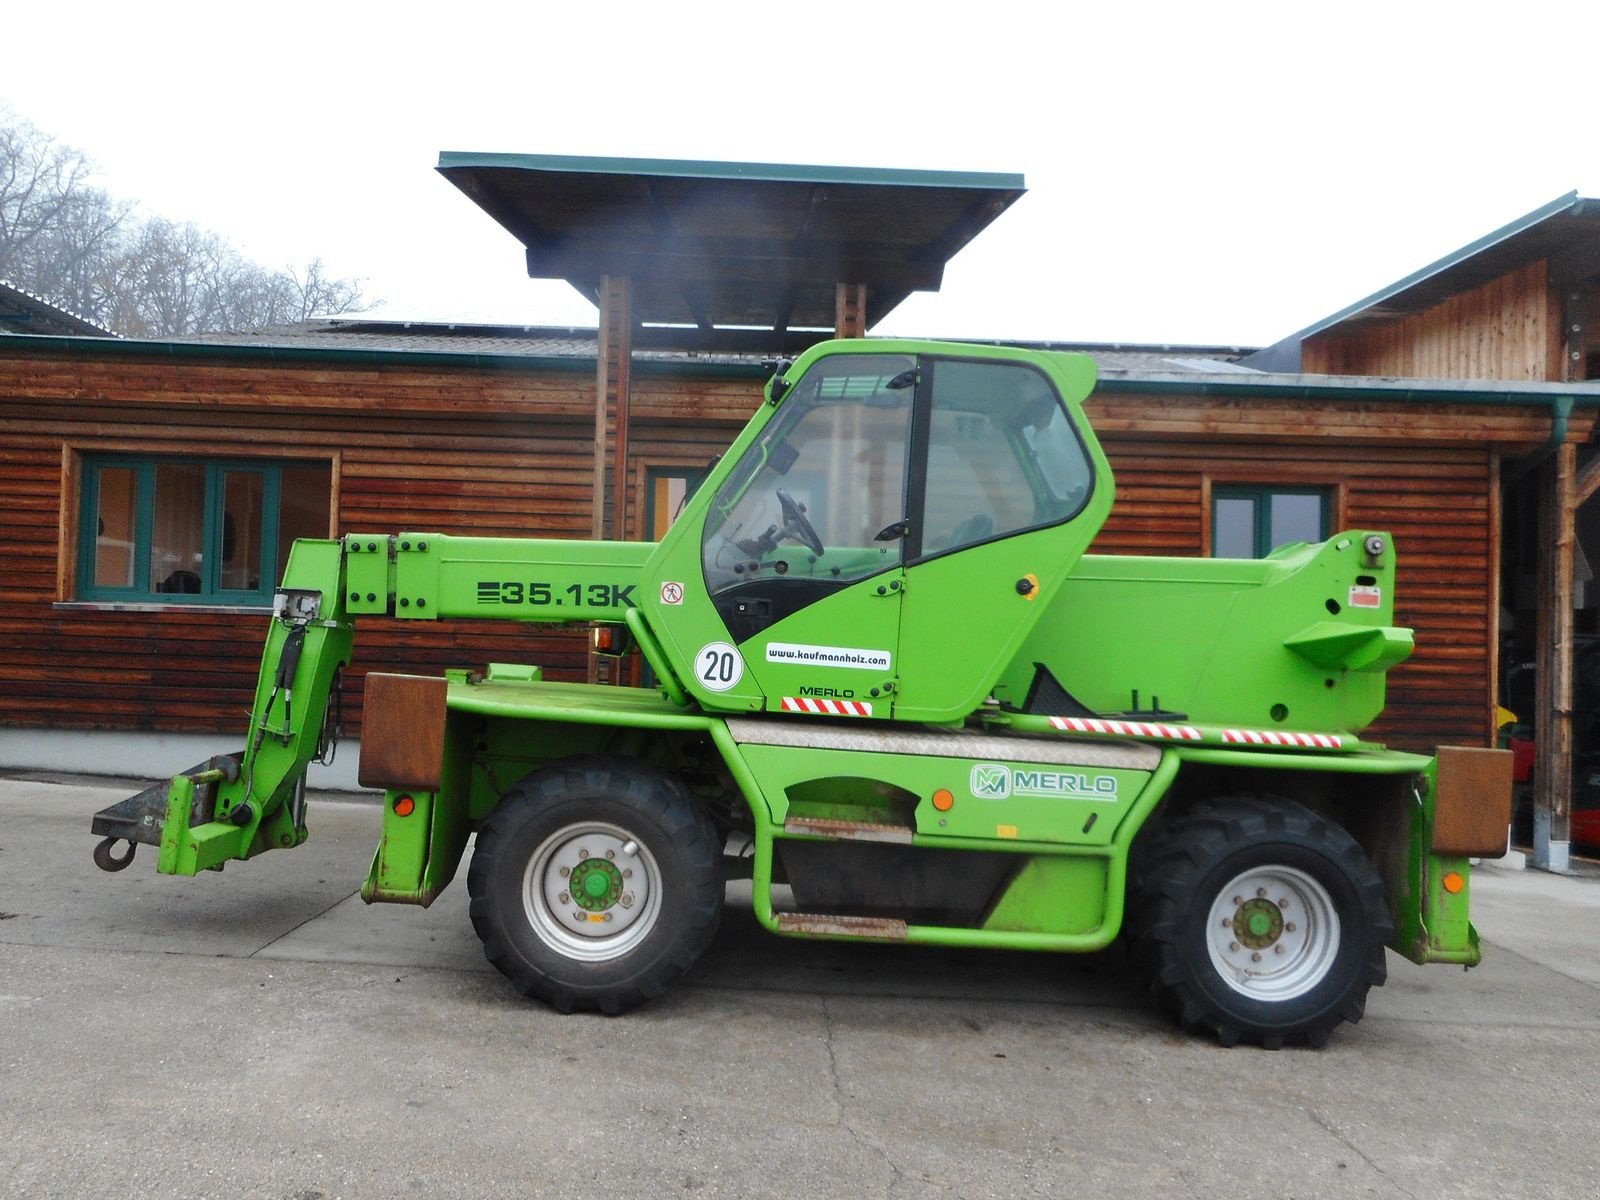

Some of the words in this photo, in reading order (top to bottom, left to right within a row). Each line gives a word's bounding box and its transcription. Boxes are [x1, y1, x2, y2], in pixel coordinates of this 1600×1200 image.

[501, 582, 637, 608] 35.13K
[703, 650, 734, 682] 20
[768, 650, 888, 666] www.kaufmannholz.com
[799, 686, 855, 699] MERLO
[1015, 771, 1116, 793] MERLO
